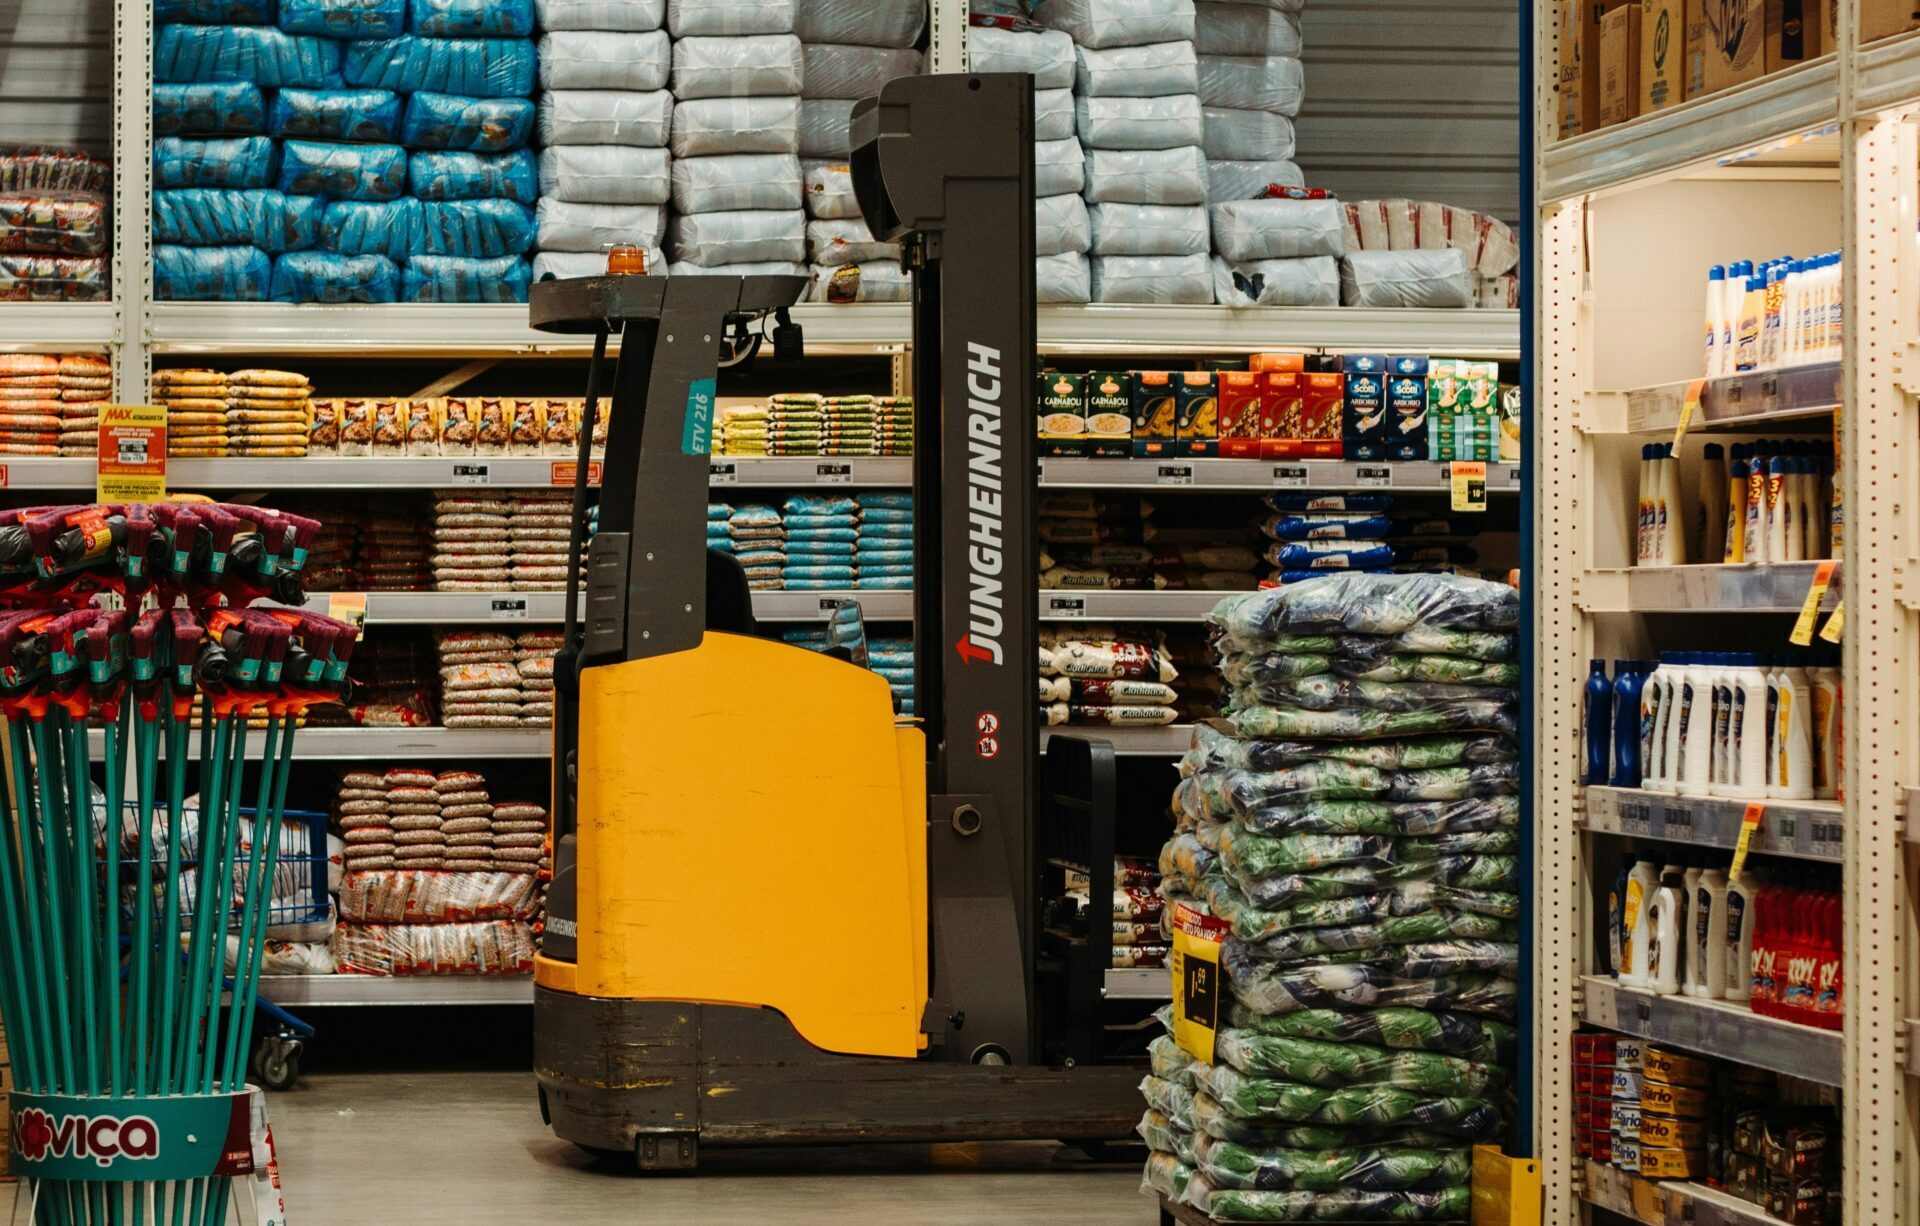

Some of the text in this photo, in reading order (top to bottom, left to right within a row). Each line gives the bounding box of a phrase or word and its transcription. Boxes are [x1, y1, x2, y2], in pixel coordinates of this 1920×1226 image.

[1044, 396, 1082, 406] CARNAROLI
[1091, 396, 1129, 406] CARNAROLI
[1350, 398, 1379, 406] ARBORIO
[1393, 399, 1421, 407] ARBORIO
[103, 408, 132, 424] MAX
[692, 393, 708, 454] ETV 216
[967, 341, 1003, 665] JUNGHEINRICH
[1065, 663, 1108, 674] Gladiador
[1121, 686, 1167, 697] Gladiador
[1120, 707, 1166, 718] Gladiador
